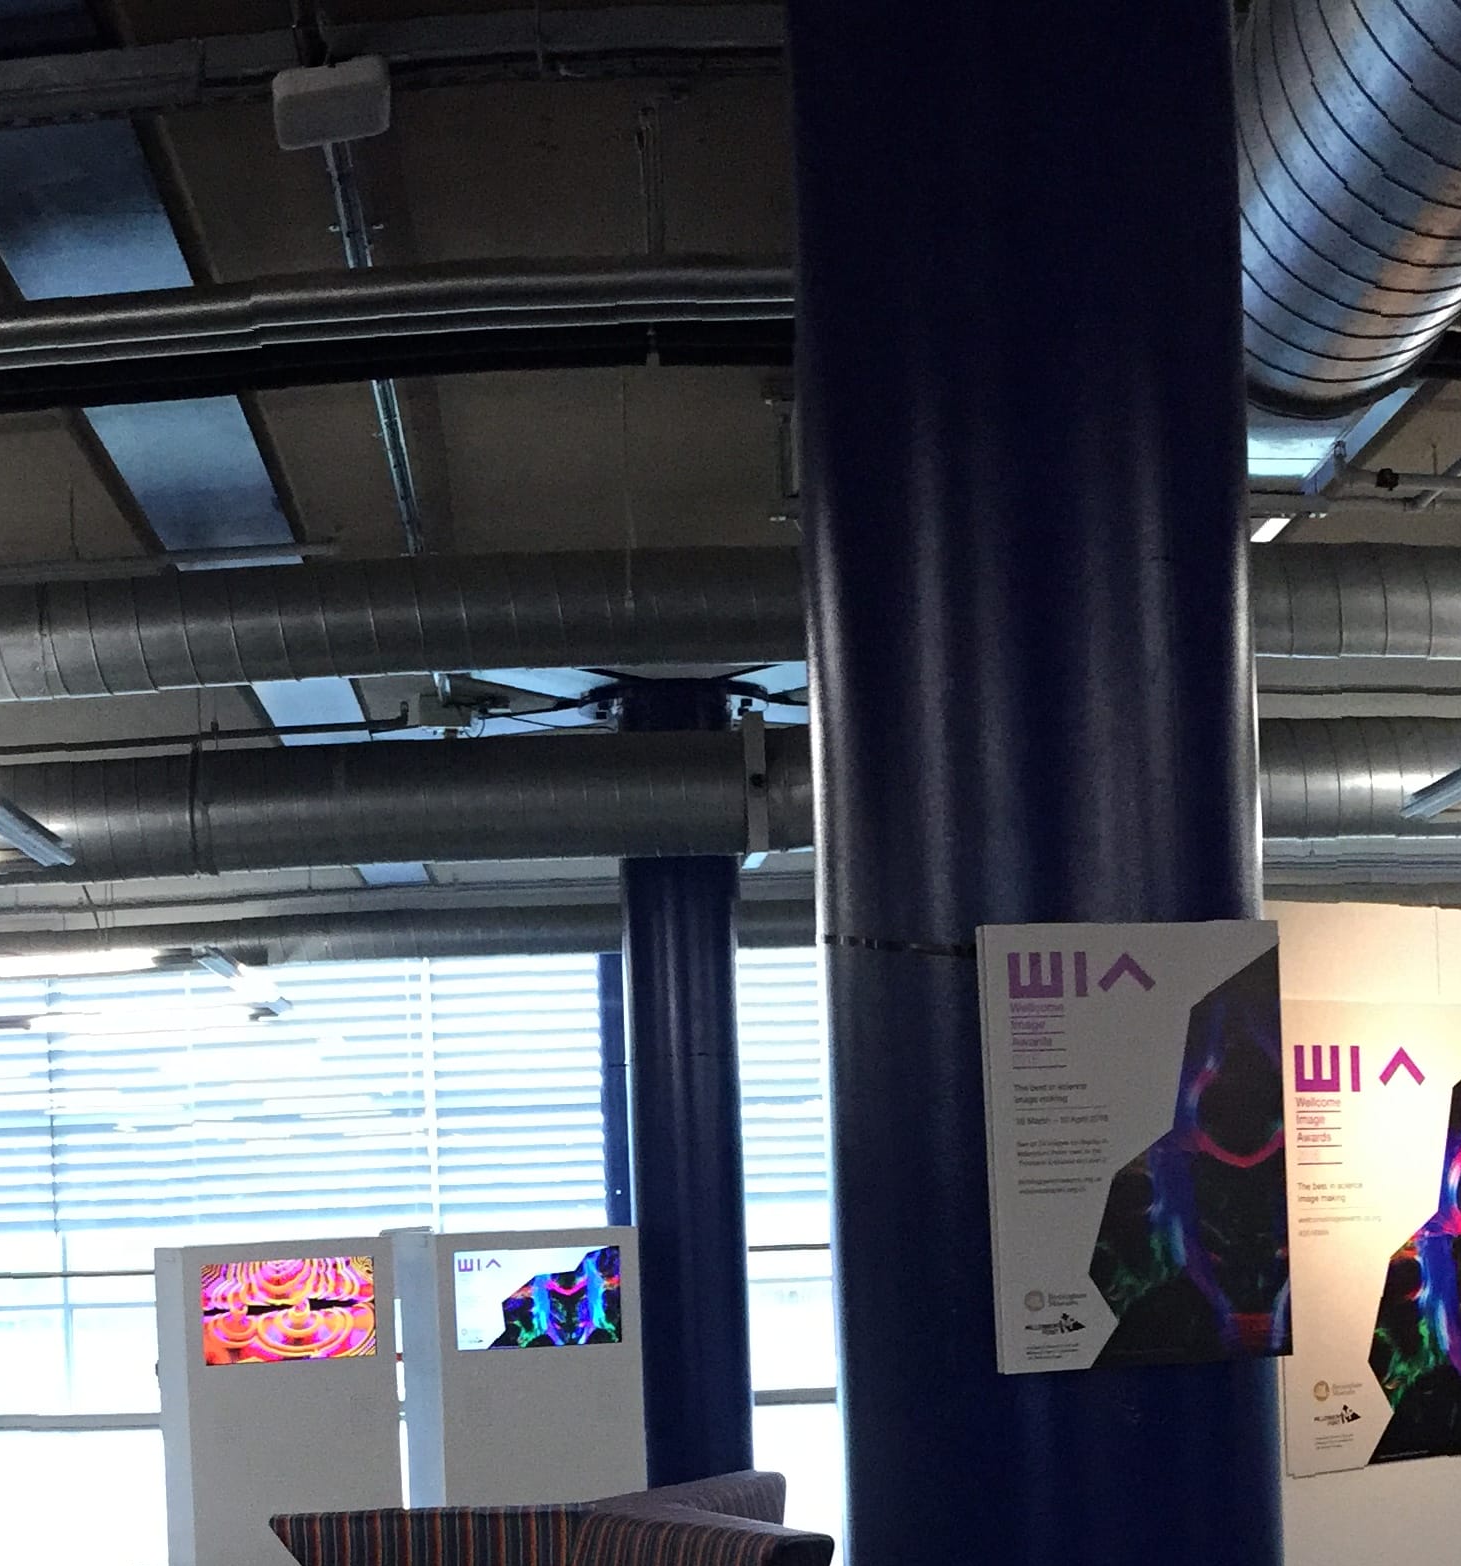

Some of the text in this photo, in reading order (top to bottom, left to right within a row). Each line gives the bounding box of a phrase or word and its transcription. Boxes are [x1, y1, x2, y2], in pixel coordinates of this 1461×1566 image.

[1295, 1097, 1341, 1108] Wellcome
[1296, 1114, 1325, 1127] Image
[1296, 1131, 1332, 1143] Awards
[1297, 1182, 1311, 1191] The
[1312, 1182, 1328, 1190] best
[1321, 1195, 1346, 1203] making
